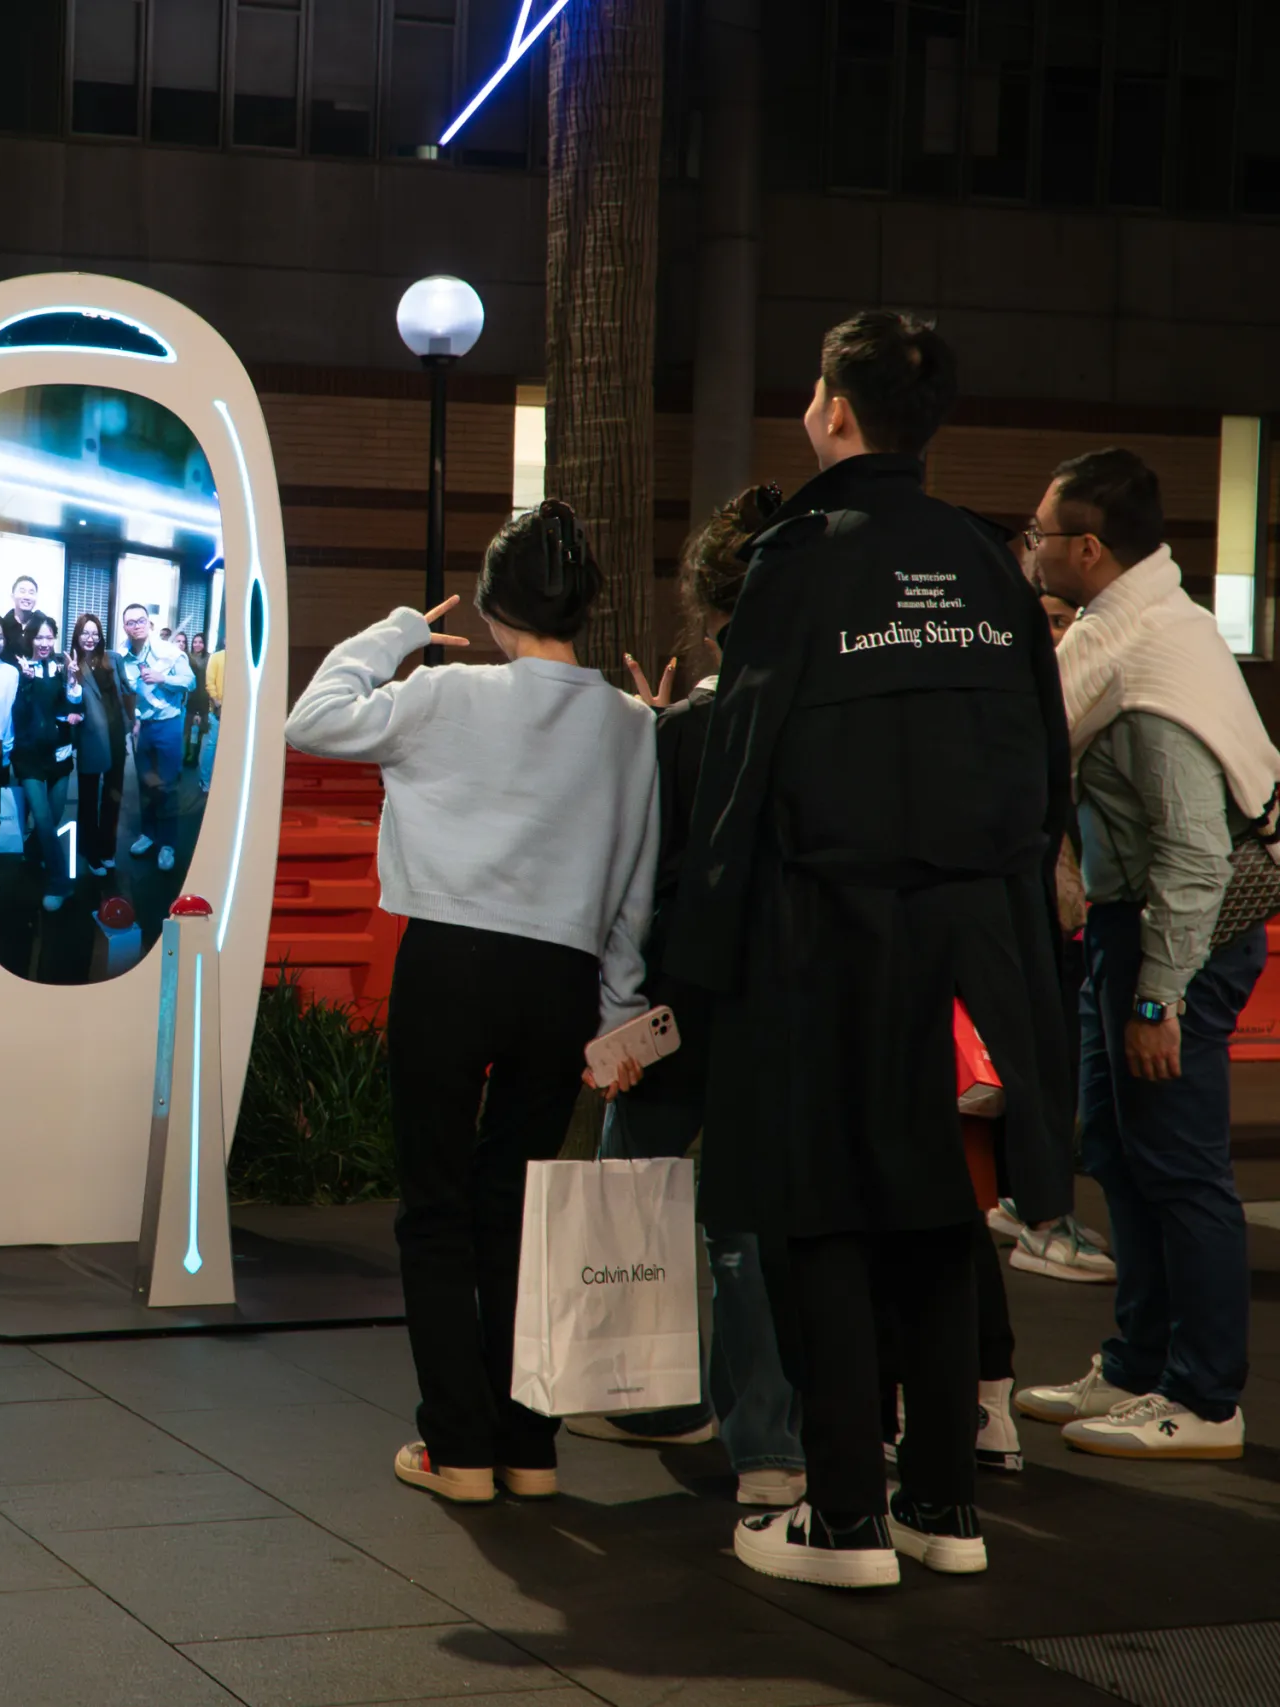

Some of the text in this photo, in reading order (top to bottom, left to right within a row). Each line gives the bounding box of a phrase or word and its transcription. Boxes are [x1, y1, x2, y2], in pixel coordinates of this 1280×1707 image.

[894, 570, 957, 583] The mysterious
[839, 620, 1013, 654] Landing Stirp One
[56, 820, 77, 879] 1
[581, 1263, 666, 1285] Calvin Klein
